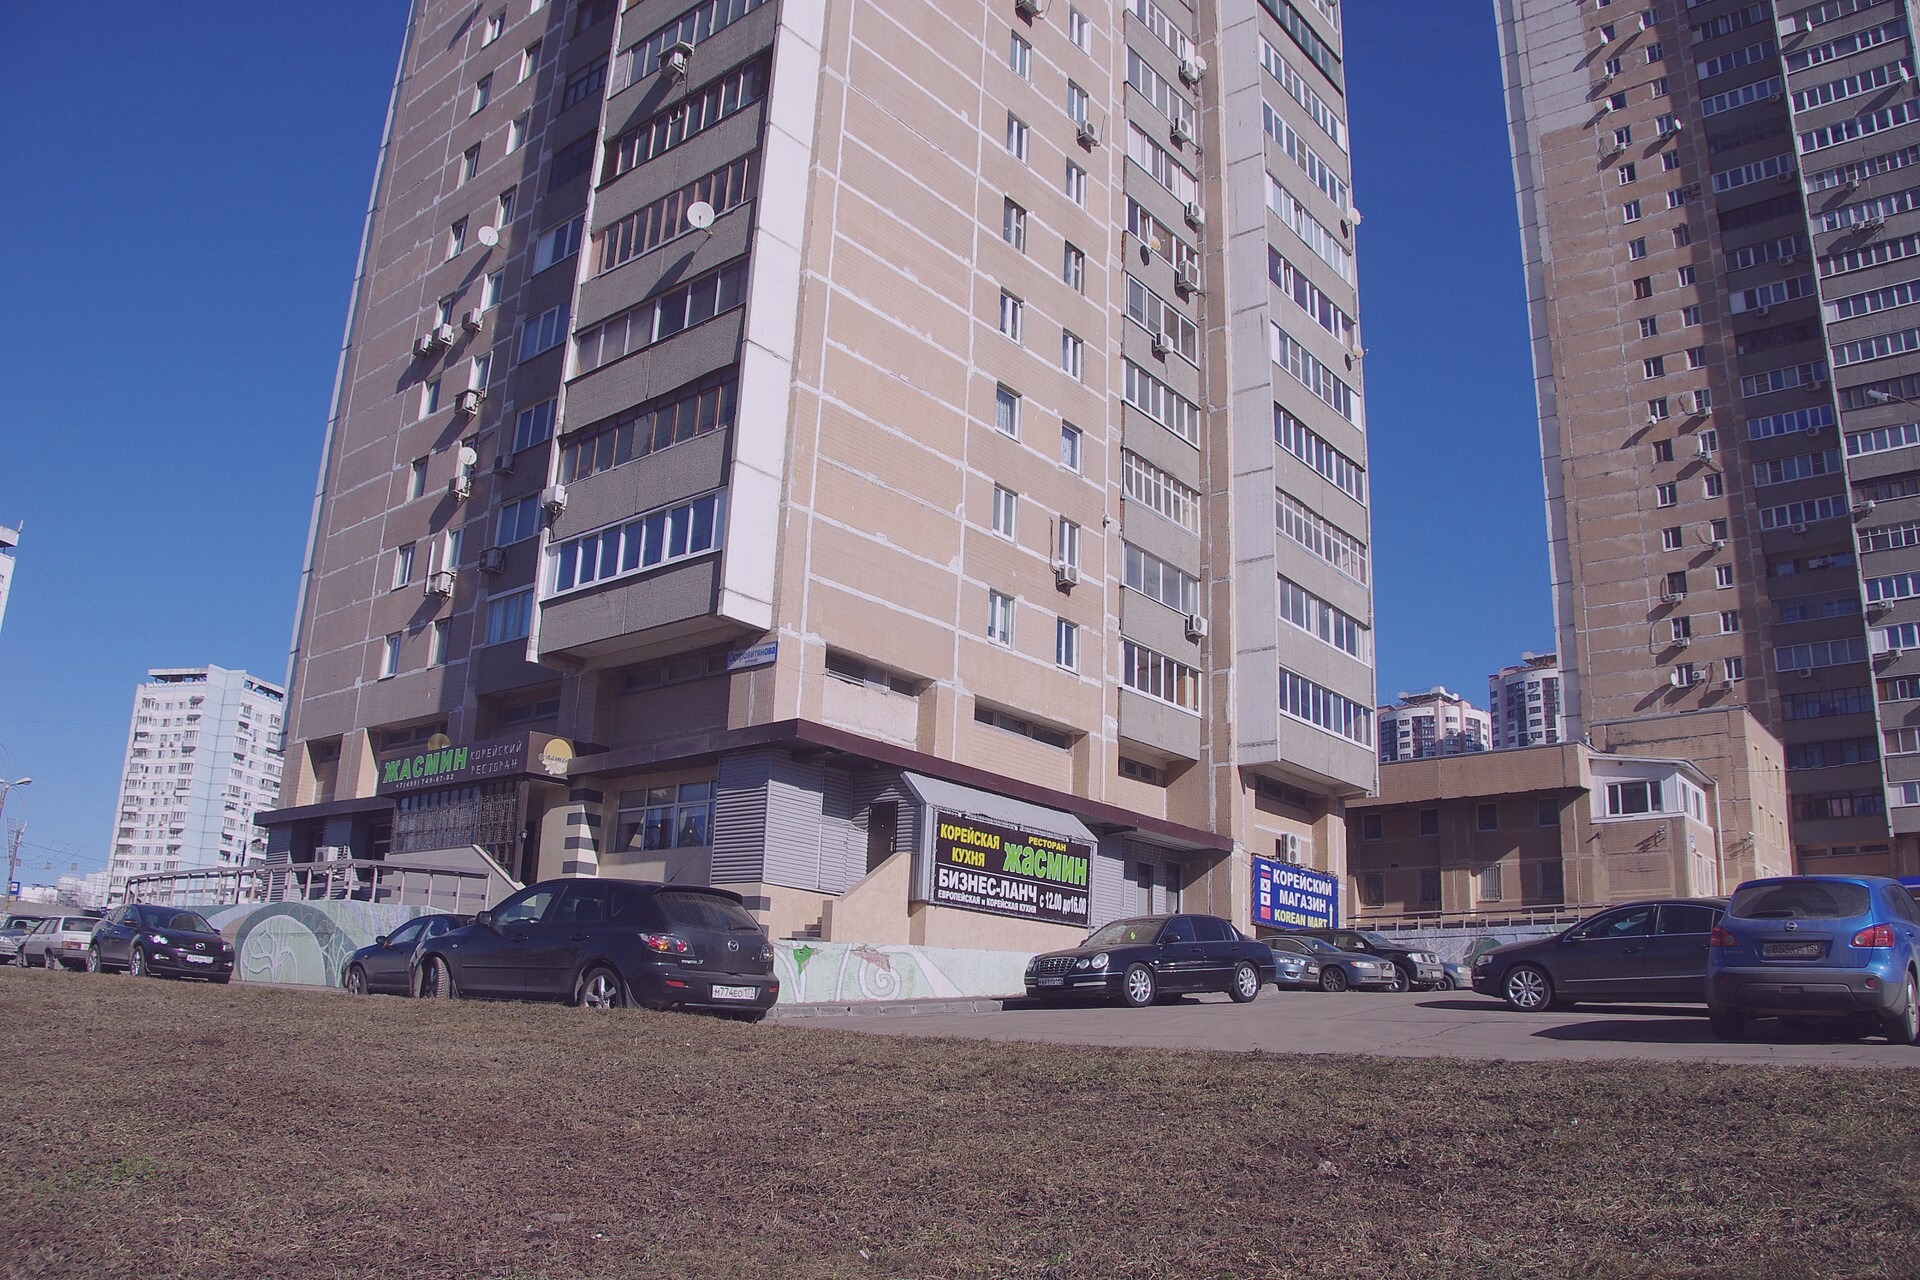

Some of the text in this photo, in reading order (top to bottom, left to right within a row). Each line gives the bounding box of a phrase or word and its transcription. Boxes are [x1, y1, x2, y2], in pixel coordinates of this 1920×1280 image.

[470, 740, 523, 761] КОРЕЙСКИЙ
[383, 747, 468, 784] ЖАСМИН
[471, 759, 518, 775] РЕСТОРАН
[940, 823, 1000, 850] КОРЕЙСКАЯ
[1028, 836, 1067, 852] РЕСТОРАН
[952, 847, 985, 867] КУХНЯ
[938, 868, 1038, 903] БИЗНЕС-ЛАНЧ
[1273, 868, 1332, 897] КОРЕЙСКИЙ
[937, 889, 981, 905] ЕВРОПЕЙСКАЯ
[986, 897, 1019, 911] КОРЕЙСКАЯ
[1019, 903, 1037, 914] КУХНЯ
[1279, 889, 1326, 914] МАГАЗИН
[1274, 908, 1328, 929] KOREAN MART
